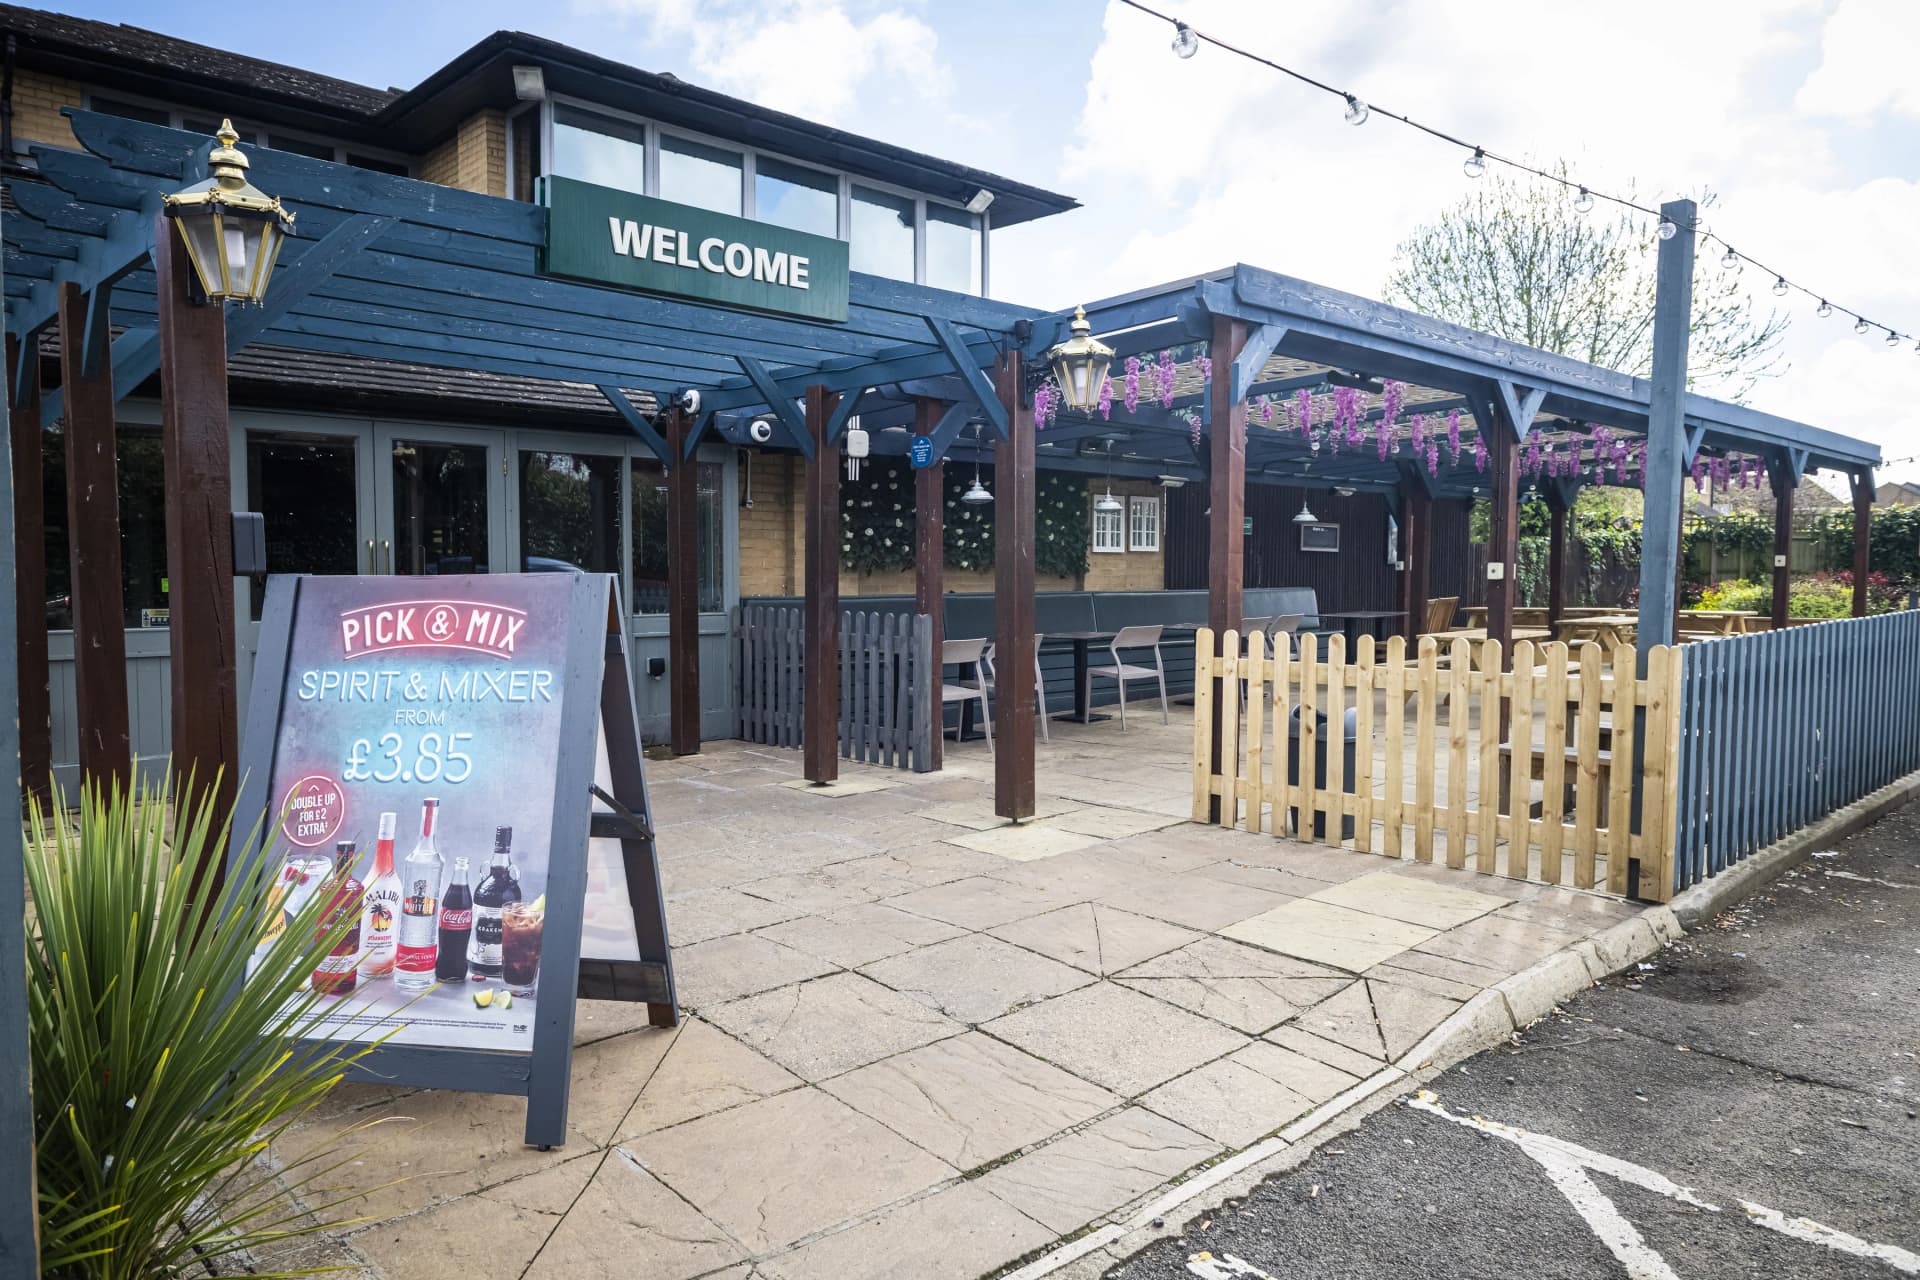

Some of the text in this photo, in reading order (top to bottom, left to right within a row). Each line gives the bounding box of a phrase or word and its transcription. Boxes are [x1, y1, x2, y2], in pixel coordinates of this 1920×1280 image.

[608, 216, 810, 290] WELCOME
[342, 608, 525, 652] PICK & MIX
[298, 670, 553, 701] SPIRIT & MIXER
[394, 709, 446, 726] FROM
[342, 732, 473, 783] £3.85
[324, 792, 336, 805] UP
[299, 808, 327, 822] FOR £2
